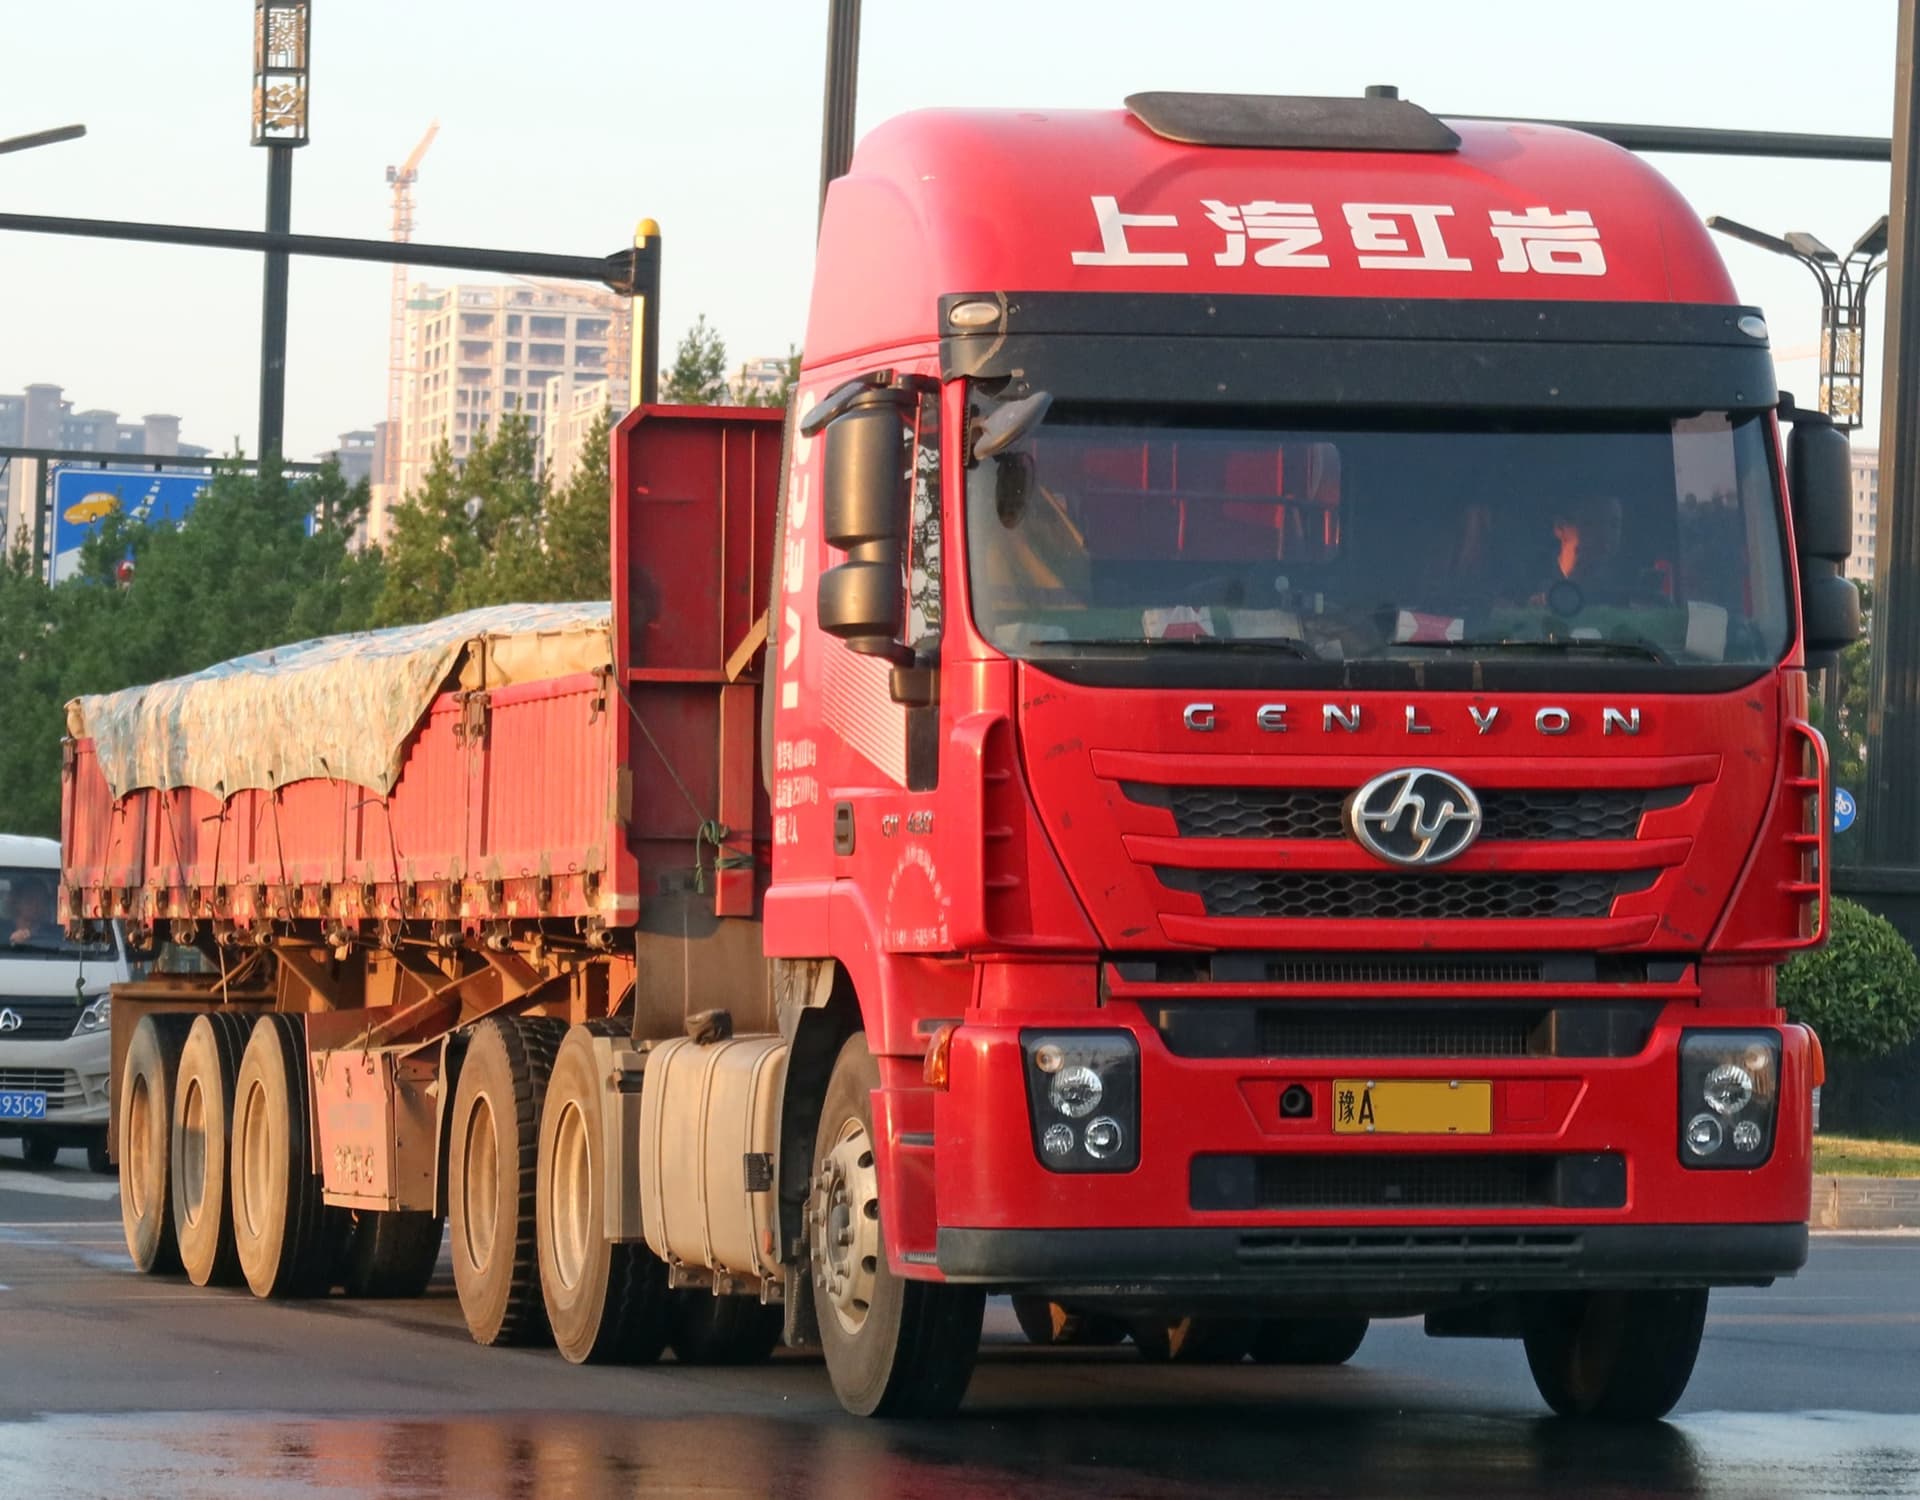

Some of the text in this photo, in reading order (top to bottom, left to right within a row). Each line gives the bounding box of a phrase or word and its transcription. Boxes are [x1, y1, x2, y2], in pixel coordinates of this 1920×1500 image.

[1071, 196, 1607, 275] 上汽红岩
[781, 390, 816, 709] IVECO
[1183, 703, 1641, 736] GENLYON
[0, 1095, 44, 1115] 93C9
